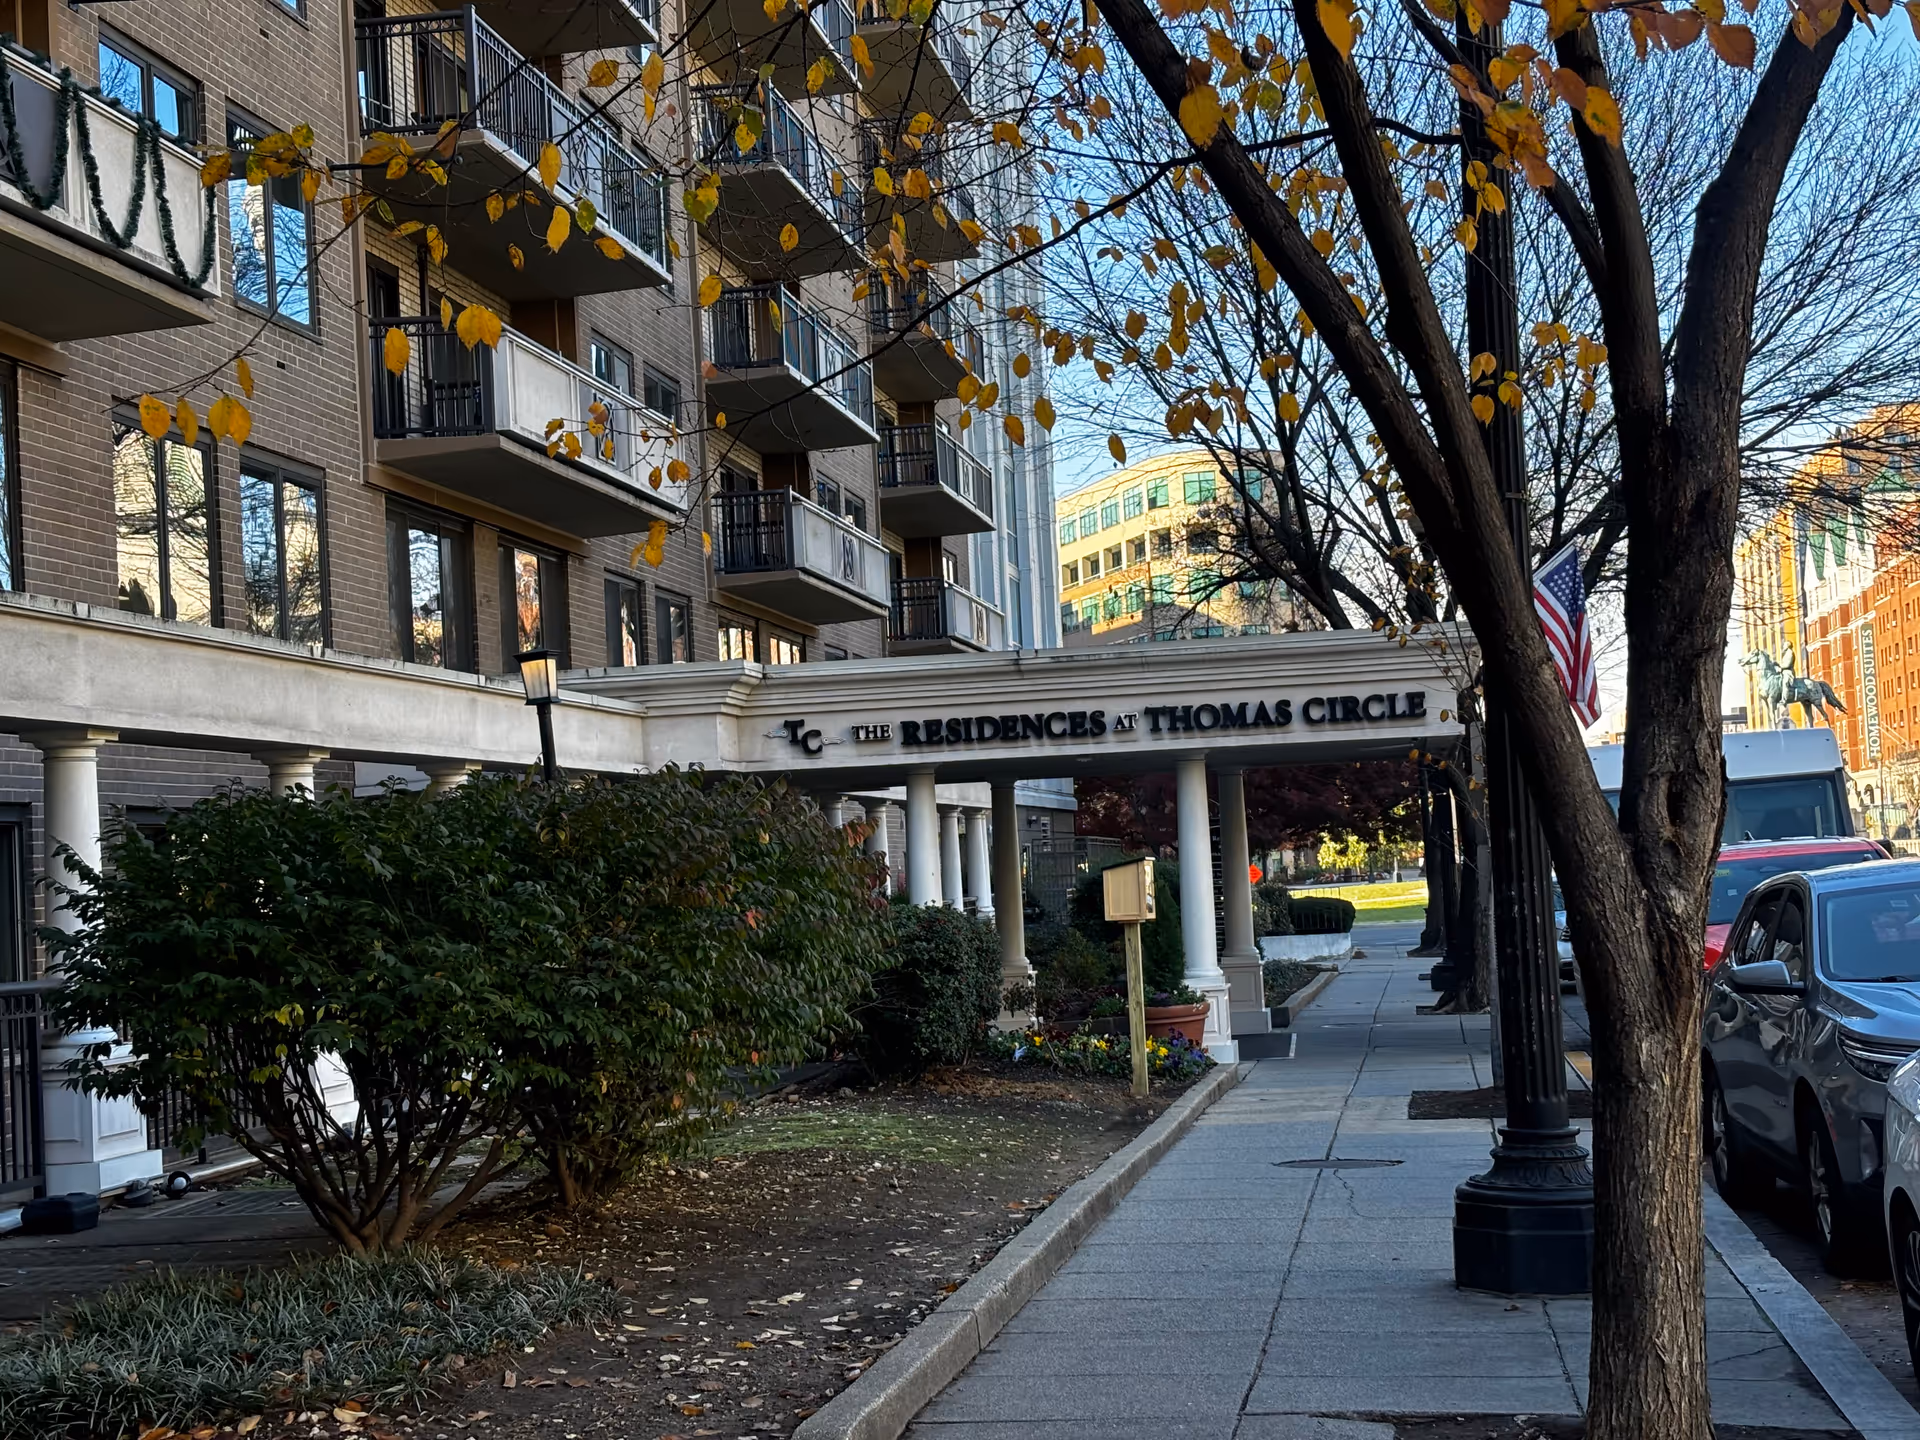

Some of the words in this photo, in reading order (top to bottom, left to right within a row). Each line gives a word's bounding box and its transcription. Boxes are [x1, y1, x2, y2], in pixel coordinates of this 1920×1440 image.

[1862, 629, 1875, 675] SUITES
[852, 724, 891, 740] THE
[900, 710, 1107, 746] RESIDENCES
[1114, 713, 1138, 729] AT
[1144, 699, 1293, 732] THOMAS
[1302, 691, 1427, 724] CIRCLE
[1865, 676, 1880, 758] HOMEWOOD
